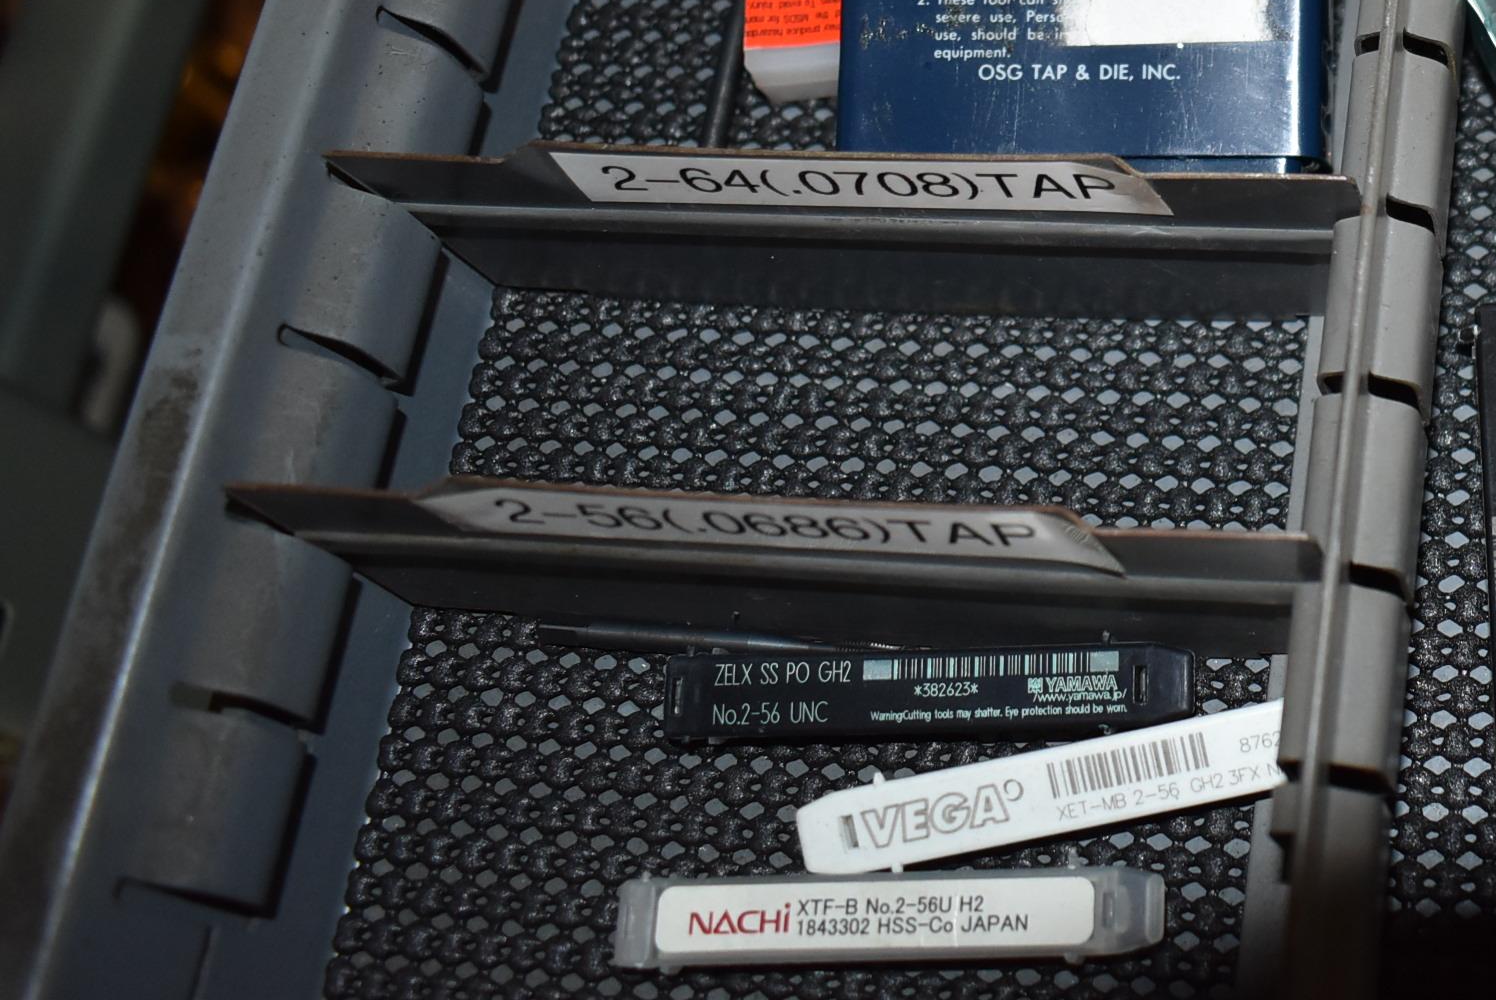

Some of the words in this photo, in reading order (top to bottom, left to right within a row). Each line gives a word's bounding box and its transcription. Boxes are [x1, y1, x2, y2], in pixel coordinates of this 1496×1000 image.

[935, 13, 981, 23] severe
[990, 14, 1017, 25] use,
[934, 31, 962, 42] use,
[971, 29, 1017, 41] should
[933, 47, 1012, 61] equipment.
[978, 64, 1023, 81] OSG
[1031, 64, 1068, 81] TAP
[1075, 64, 1090, 81] &
[1100, 64, 1134, 83] DIE,
[1142, 64, 1181, 81] INC.
[600, 164, 1116, 200] 2-64(.0708)TAP
[493, 496, 1039, 550] 2-56(.0686)TAP
[714, 663, 752, 686] ZELX
[760, 662, 779, 685] SS
[786, 661, 810, 684] PO
[818, 660, 852, 684] GH2
[1045, 674, 1119, 693] YAMAWA
[712, 702, 780, 725] No.2-56
[790, 701, 829, 724] UNC
[935, 709, 954, 719] tools
[956, 710, 972, 722] may
[975, 707, 1003, 718] shatter.
[1005, 706, 1019, 720] Eye
[1021, 706, 1063, 719] protection
[1065, 704, 1091, 715] should
[1092, 703, 1104, 714] be
[1106, 704, 1128, 714] worn.
[1057, 792, 1128, 822] XET-MB
[1134, 782, 1181, 807] 2-56
[1190, 773, 1224, 795] GH2
[1228, 766, 1261, 787] 3FX
[861, 783, 1011, 850] VEGA
[796, 899, 859, 917] XTF-B
[866, 896, 952, 915] No.2-56U
[959, 895, 984, 913] H2
[797, 916, 870, 936] 1843302
[877, 916, 954, 935] HSS-Co
[961, 914, 1029, 934] JAPAN
